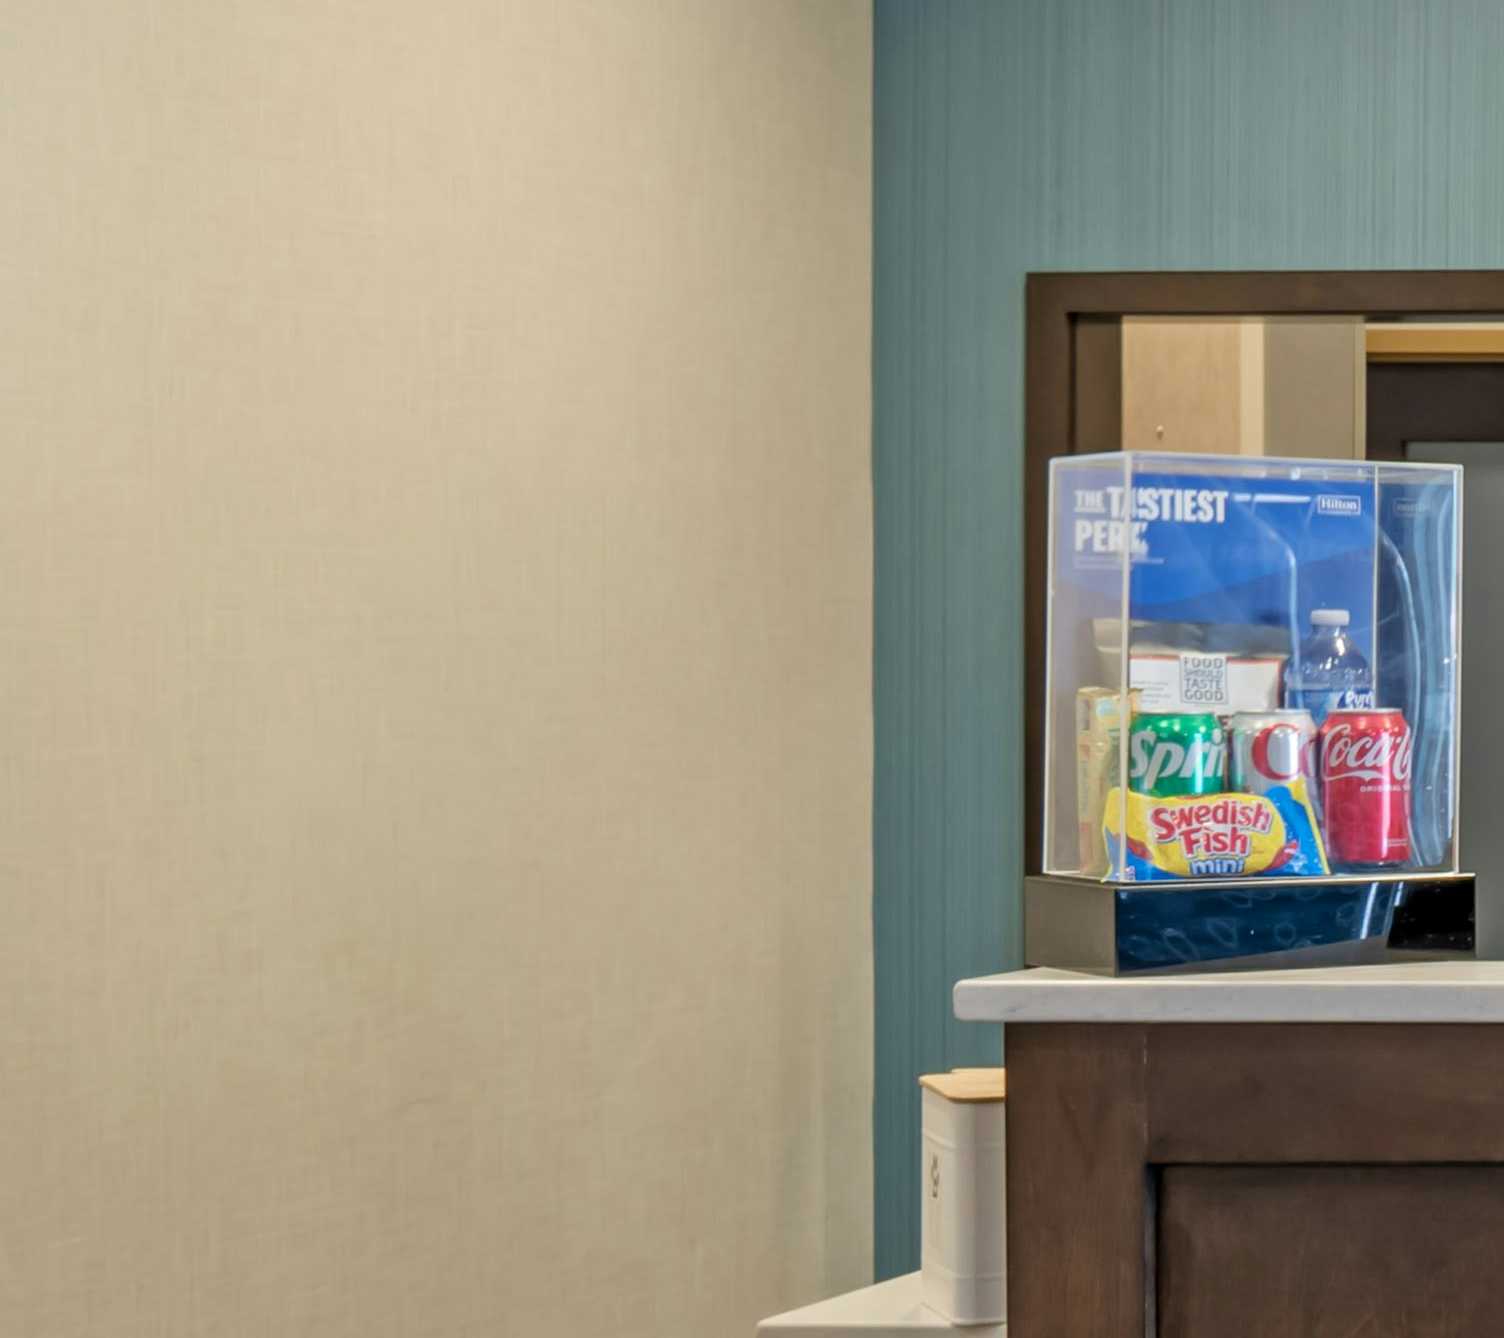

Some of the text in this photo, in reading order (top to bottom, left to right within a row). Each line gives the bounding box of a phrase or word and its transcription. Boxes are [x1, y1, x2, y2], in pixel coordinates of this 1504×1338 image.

[1074, 490, 1103, 507] THE
[1321, 498, 1357, 510] Hilton
[1183, 657, 1223, 668] FOOD
[1184, 669, 1223, 678] SHOULD
[1184, 678, 1223, 689] TASTE
[1184, 690, 1224, 701] GOOD
[1151, 800, 1271, 841] Swedish
[1178, 826, 1249, 856] Fish
[1190, 859, 1245, 875] mini
